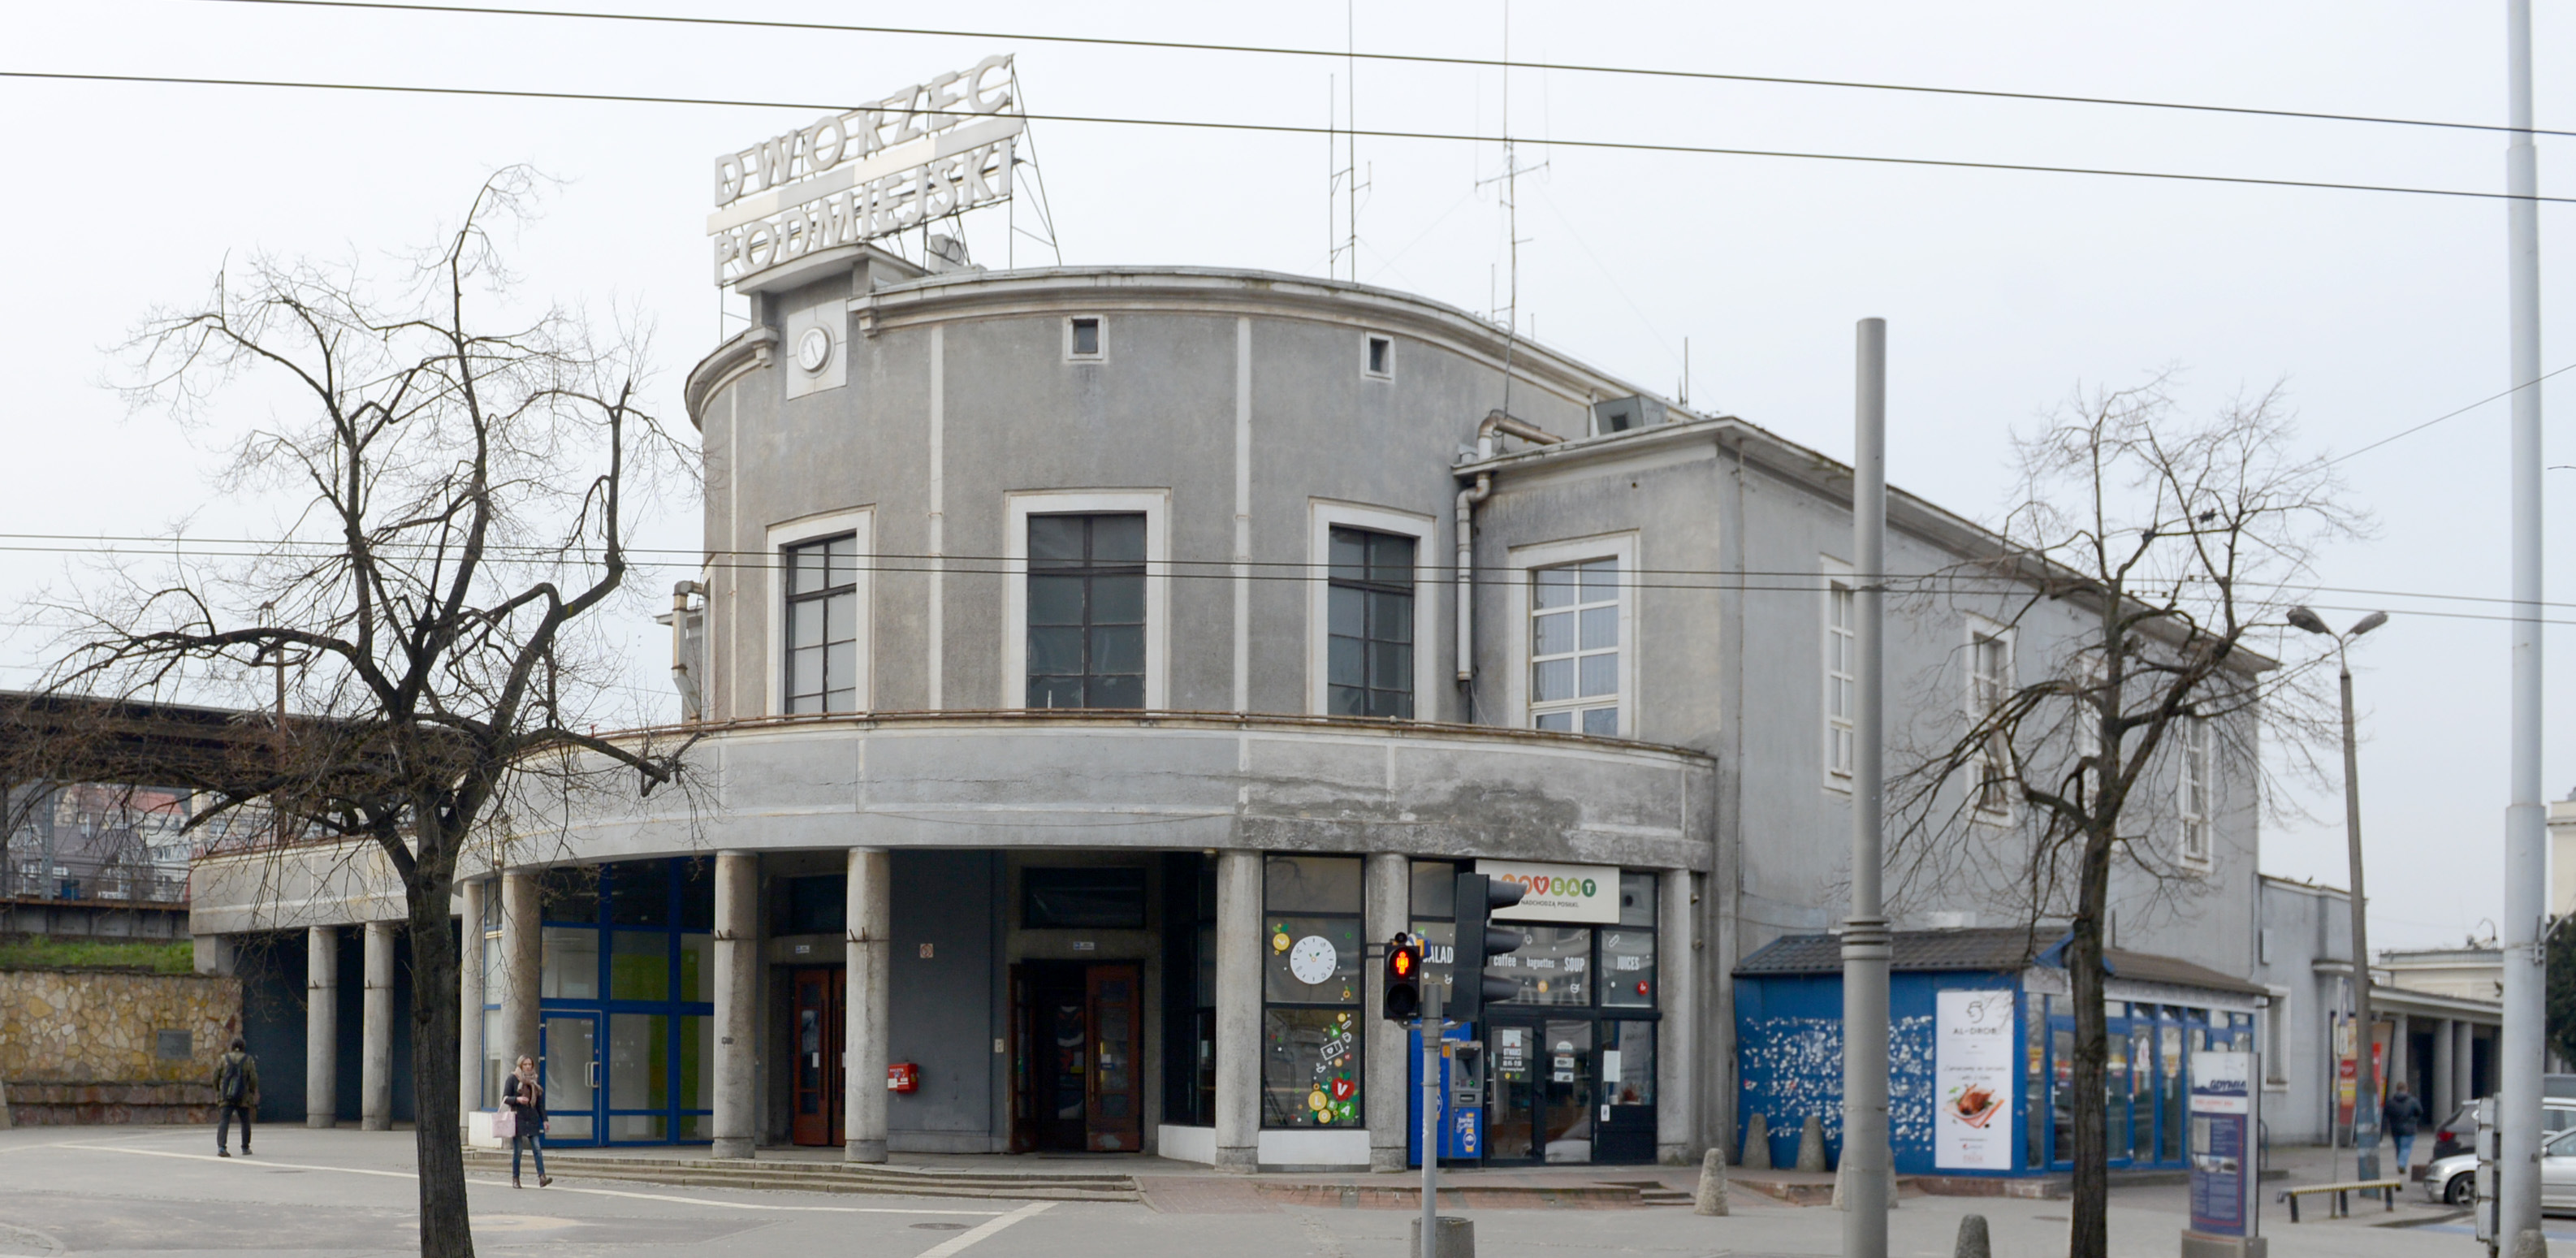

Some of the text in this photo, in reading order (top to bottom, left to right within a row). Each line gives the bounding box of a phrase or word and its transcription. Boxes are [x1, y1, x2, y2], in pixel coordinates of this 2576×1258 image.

[715, 54, 1012, 207] DWORZEC
[714, 136, 1012, 286] PODMIEJSKI
[1493, 953, 1585, 972] coffee baguettes SOUP
[1617, 955, 1640, 971] JUICES
